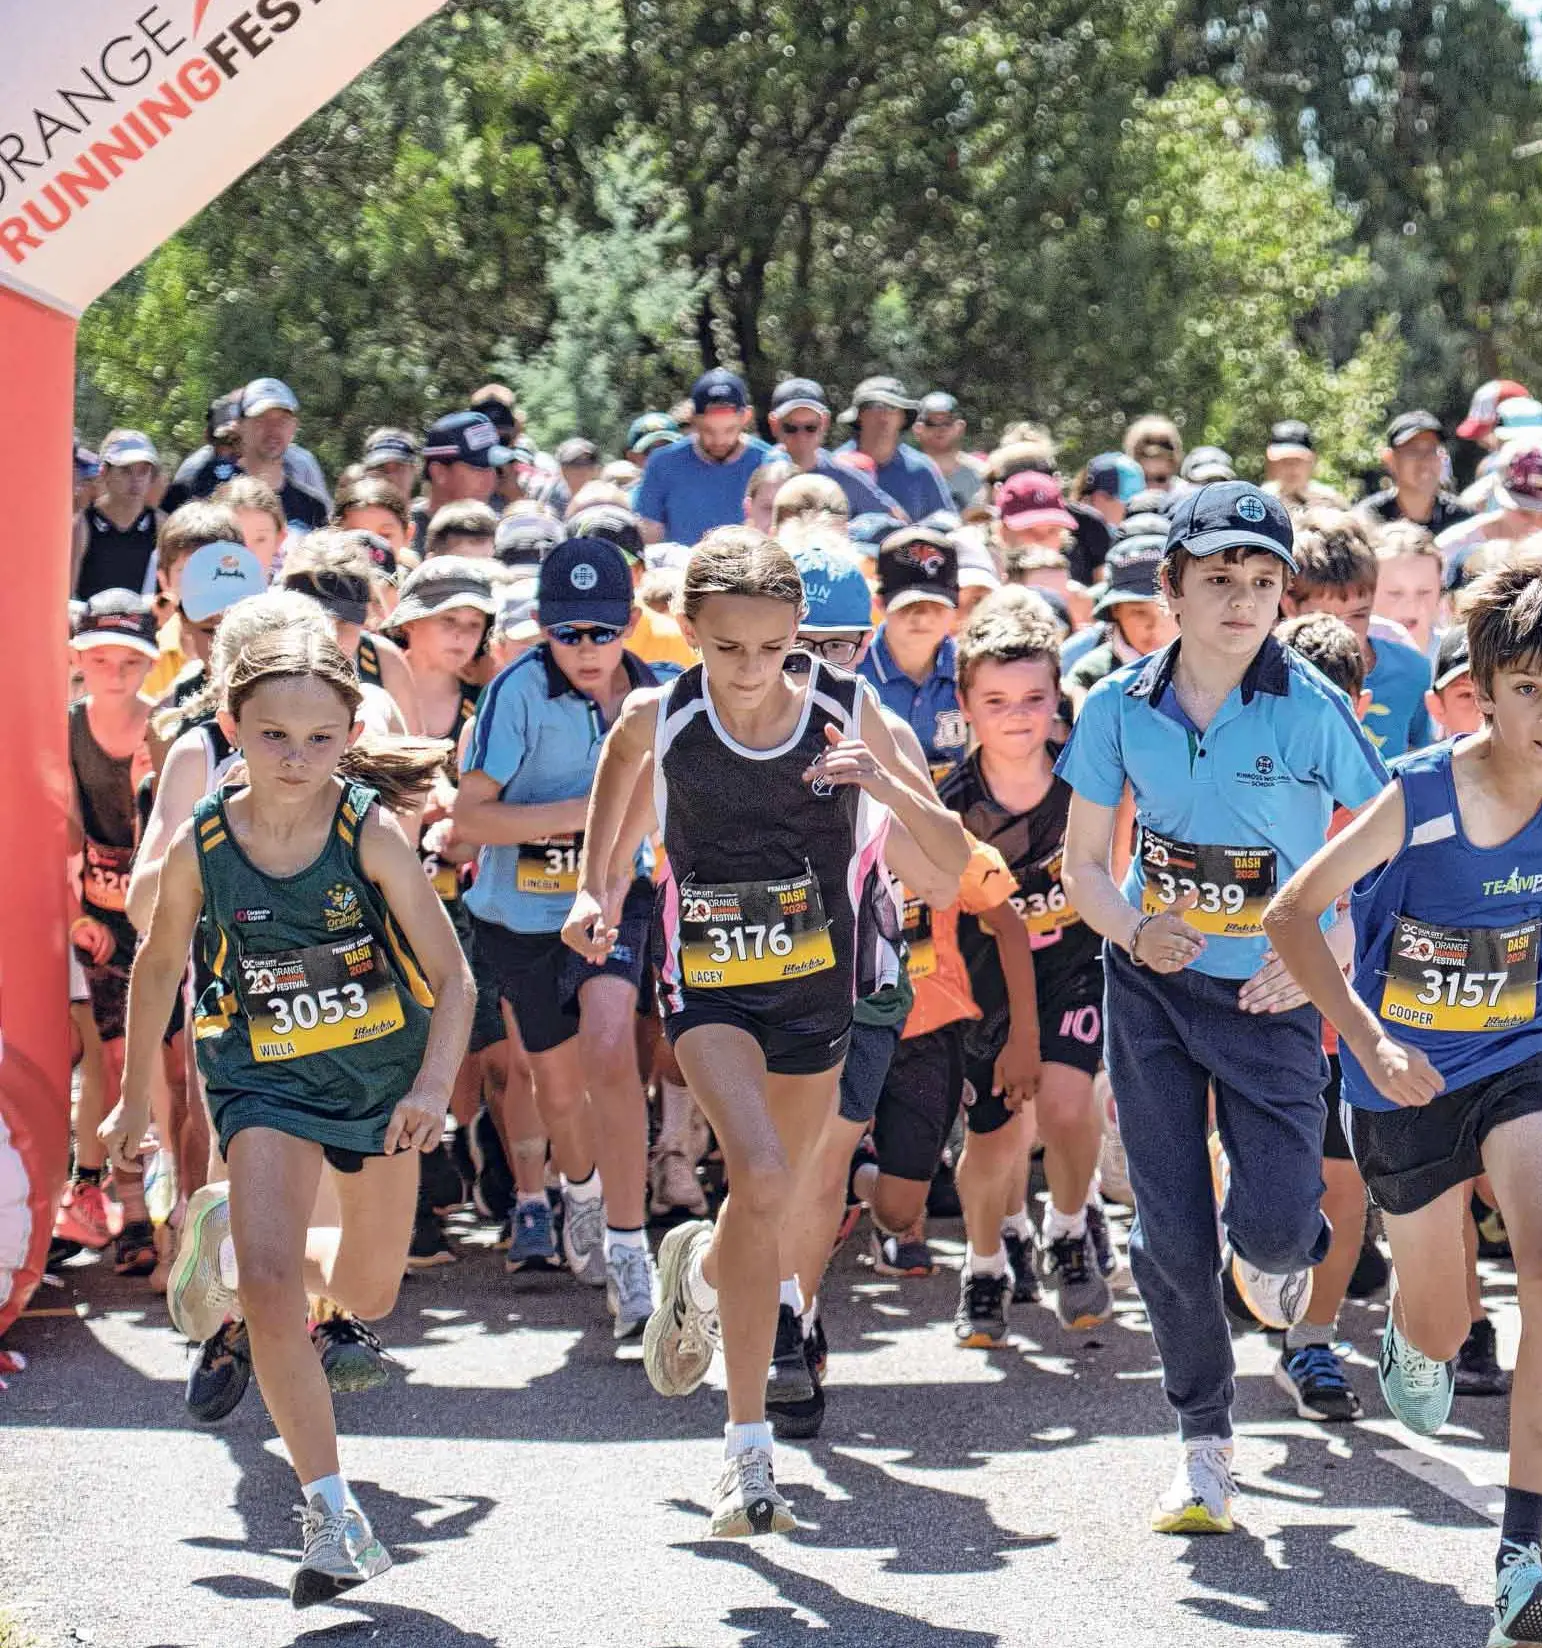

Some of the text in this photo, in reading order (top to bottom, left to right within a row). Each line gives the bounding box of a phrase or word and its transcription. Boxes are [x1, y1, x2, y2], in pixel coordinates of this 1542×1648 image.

[0, 5, 187, 200] RANGE
[0, 0, 324, 264] RUNNINGFES
[1234, 857, 1261, 869] DASH
[767, 878, 812, 893] PRIMARY SCHOOL
[779, 889, 807, 904] DASH
[682, 898, 739, 922] 20 ORANGE
[783, 902, 808, 915] 2026
[712, 913, 743, 922] FESTIVAL
[1402, 923, 1418, 934] OC
[1500, 925, 1536, 940] PRIMARY SCHOOL
[332, 942, 355, 955] PRIMARY
[707, 922, 793, 963] 3176
[1397, 934, 1468, 962] 20 ORANGE
[1507, 935, 1529, 952] DASH
[345, 946, 372, 965] DASH
[1432, 956, 1466, 967] FESTIVAL
[241, 960, 255, 969] OC
[349, 959, 374, 977] 2026
[244, 964, 305, 995] 20 ORANGE
[691, 970, 723, 983] LACEY
[276, 980, 309, 992] FESTIVAL
[1416, 969, 1508, 1007] 3157
[267, 982, 368, 1035] 3053
[1388, 1003, 1433, 1025] COOPER
[1059, 1005, 1100, 1044] 10
[259, 1042, 295, 1057] WILLA
